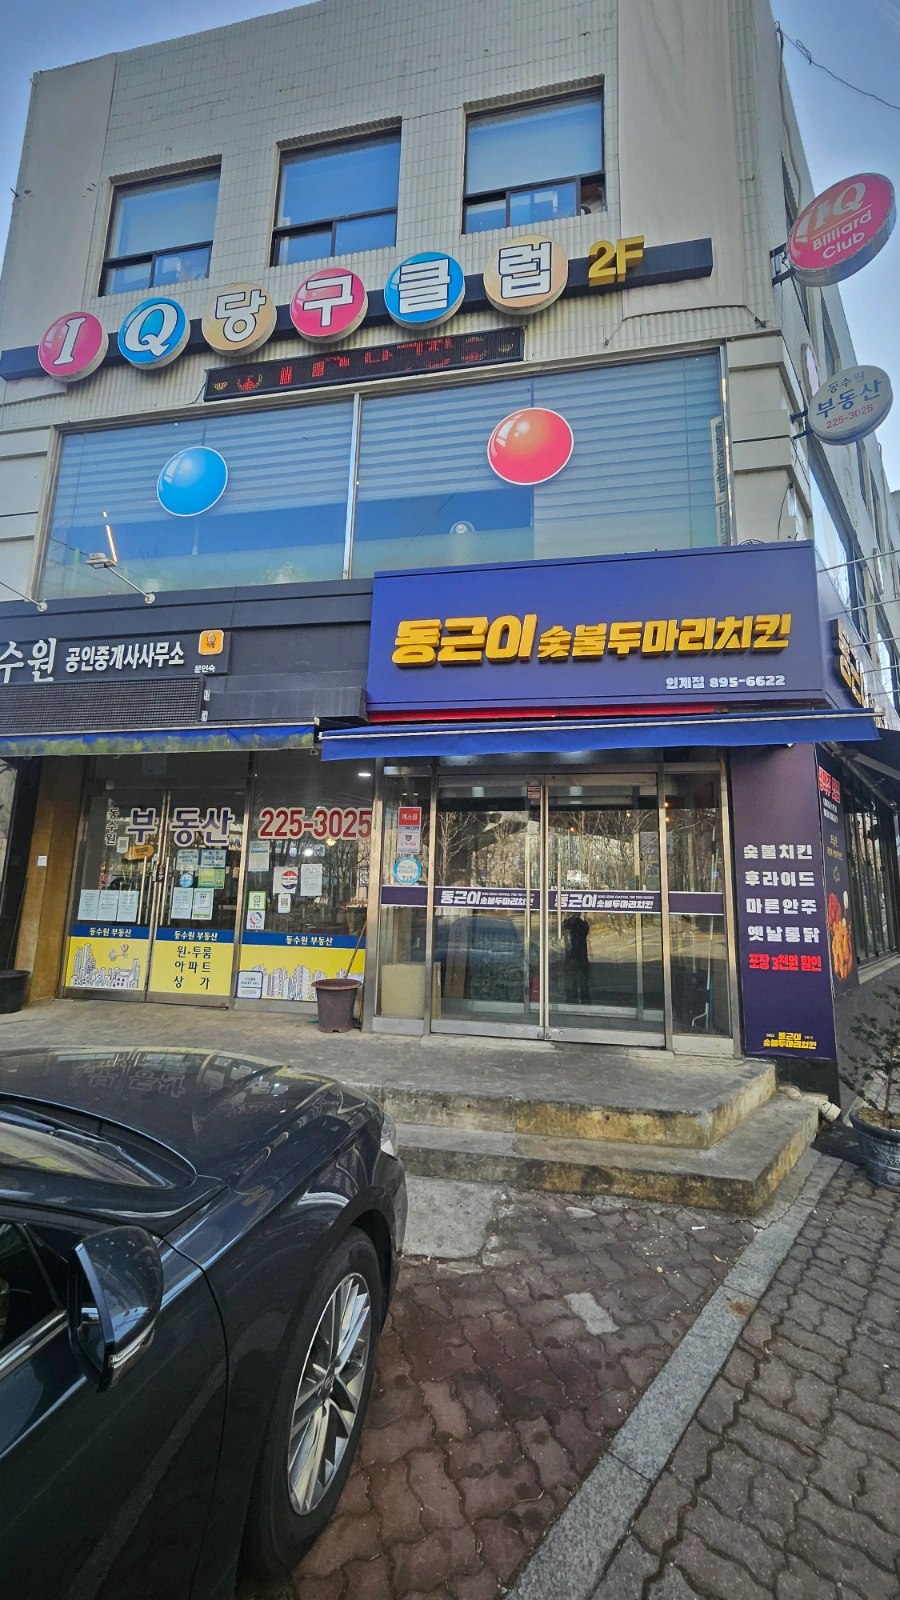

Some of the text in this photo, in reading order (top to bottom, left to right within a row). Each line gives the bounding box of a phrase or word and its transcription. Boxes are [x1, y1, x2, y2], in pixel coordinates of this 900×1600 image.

[813, 209, 872, 251] Billiard
[822, 232, 866, 259] Club
[588, 234, 645, 287] 2F
[828, 370, 866, 393] 동수원
[816, 379, 882, 418] 부동산
[826, 403, 874, 430] 225-3025
[391, 613, 538, 665] 동근이
[65, 641, 185, 673] 공인중개사사무소
[666, 674, 786, 690] 인계점 895-6622
[105, 806, 120, 846] 동수원
[125, 807, 236, 848] 부동산
[258, 808, 372, 840] 225-3025
[743, 844, 813, 860] 숯불치킨
[745, 870, 815, 887] 후라이드
[440, 890, 481, 905] 동근이
[554, 893, 597, 908] 동근이
[745, 898, 817, 915] 마른안주
[89, 927, 132, 937] 동수원 부동산
[174, 930, 218, 941] 동수원 부동산
[285, 935, 333, 946] 동수원 부동산
[747, 925, 820, 943] 옛날통닭
[174, 961, 211, 974] 아파트
[749, 953, 822, 972] 포장 3천원 할인
